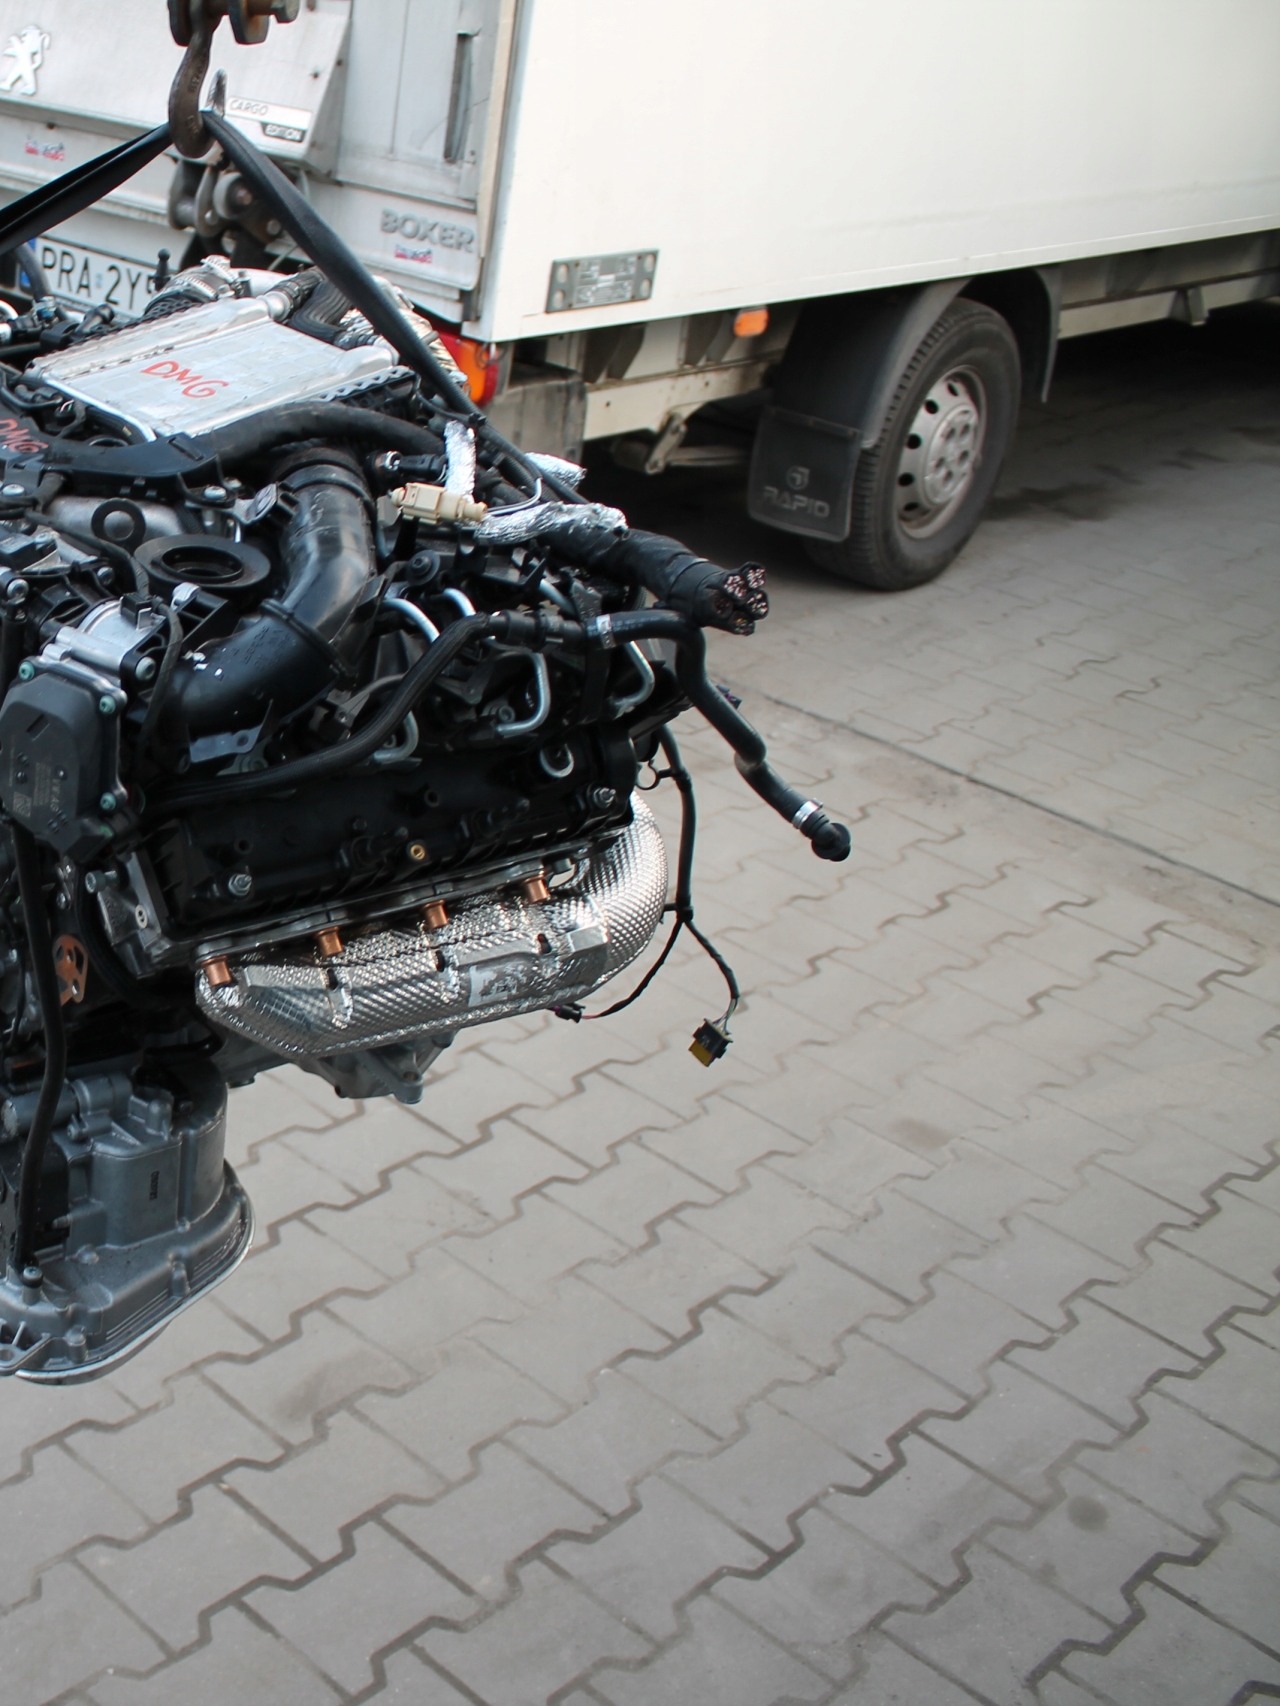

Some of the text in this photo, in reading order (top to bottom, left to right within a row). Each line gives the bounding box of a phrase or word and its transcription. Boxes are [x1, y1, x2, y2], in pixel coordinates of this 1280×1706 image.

[230, 98, 268, 116] CARGO
[265, 123, 302, 141] EDITION
[381, 207, 476, 254] BOXER
[42, 245, 92, 299] PRA
[140, 360, 230, 398] DMG
[763, 485, 831, 518] RAPID
